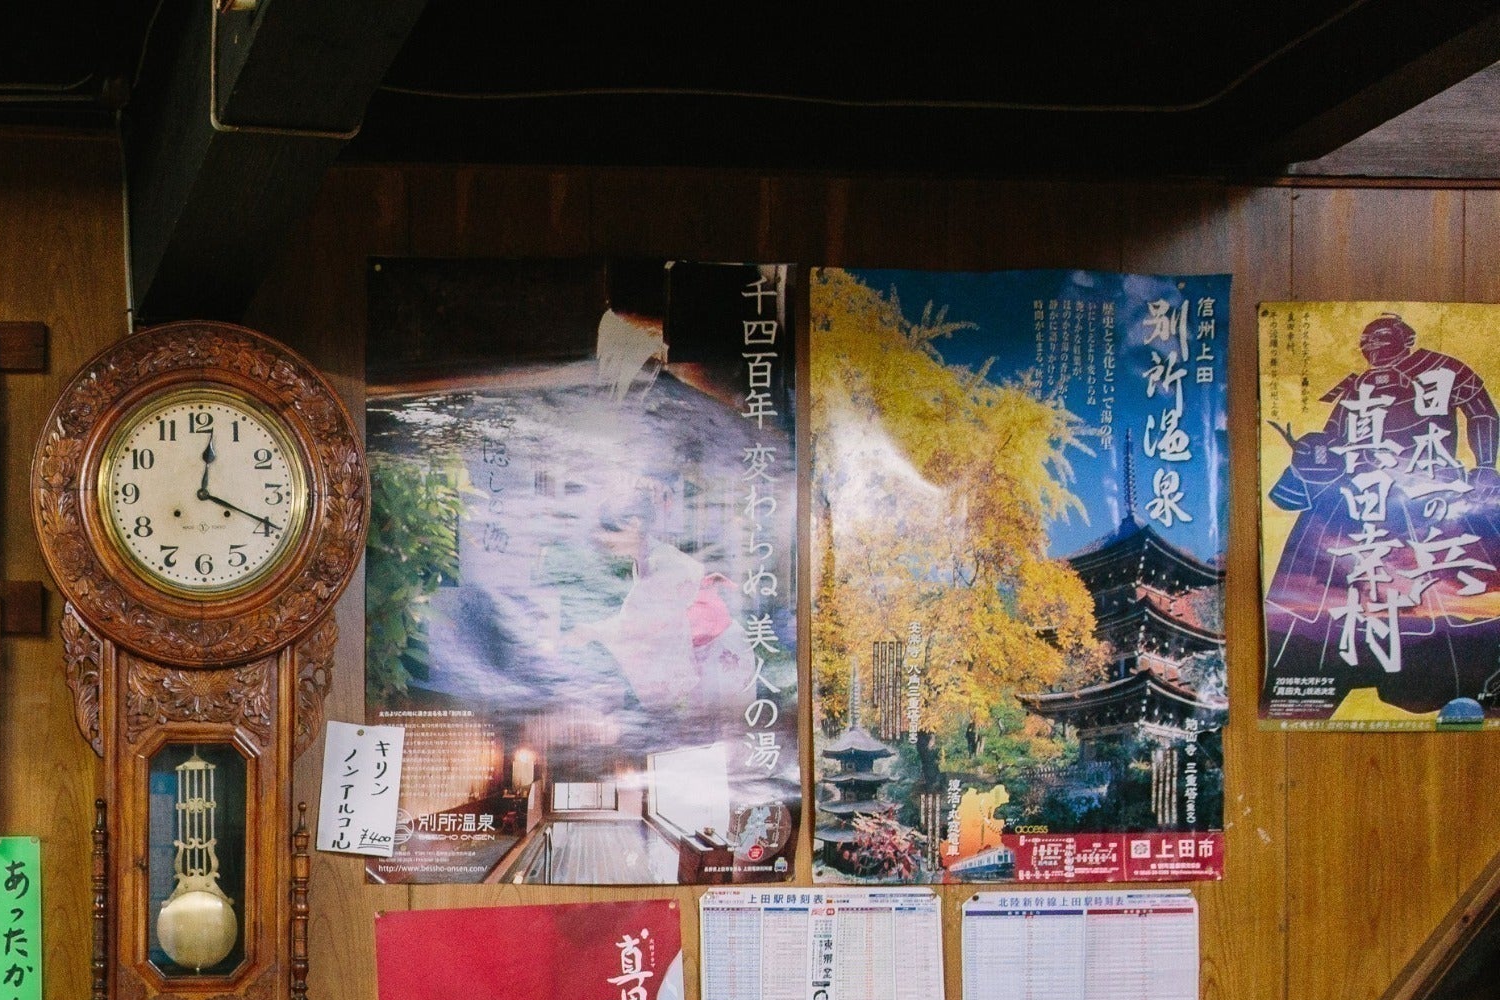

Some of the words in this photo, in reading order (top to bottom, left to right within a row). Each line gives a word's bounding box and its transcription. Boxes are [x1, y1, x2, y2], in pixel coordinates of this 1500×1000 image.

[1196, 296, 1216, 384] 信州上田
[741, 276, 778, 430] 千四百年
[188, 412, 214, 433] 12
[1142, 298, 1192, 528] 別所温泉
[159, 420, 176, 441] 11
[231, 421, 239, 442] 1
[132, 449, 154, 470] 10
[254, 449, 272, 469] 2
[1400, 368, 1496, 596] 日本一の兵
[122, 483, 139, 504] 9
[265, 483, 283, 505] 3
[134, 516, 153, 537] 8
[253, 517, 273, 537] 4
[742, 445, 778, 598] 変わらぬ
[1326, 383, 1403, 673] 真田幸村
[160, 545, 179, 567] 7
[195, 554, 213, 575] 6
[228, 544, 247, 566] 5
[742, 612, 781, 769] 美人の湯
[371, 741, 390, 795] キリン
[332, 749, 359, 849] ノンアルコール
[419, 814, 495, 831] 別所温泉
[1156, 839, 1214, 858] 上田市
[748, 894, 824, 904] 上田駅時刻表
[999, 896, 1124, 907] 北陸新幹線上田駅時刻表
